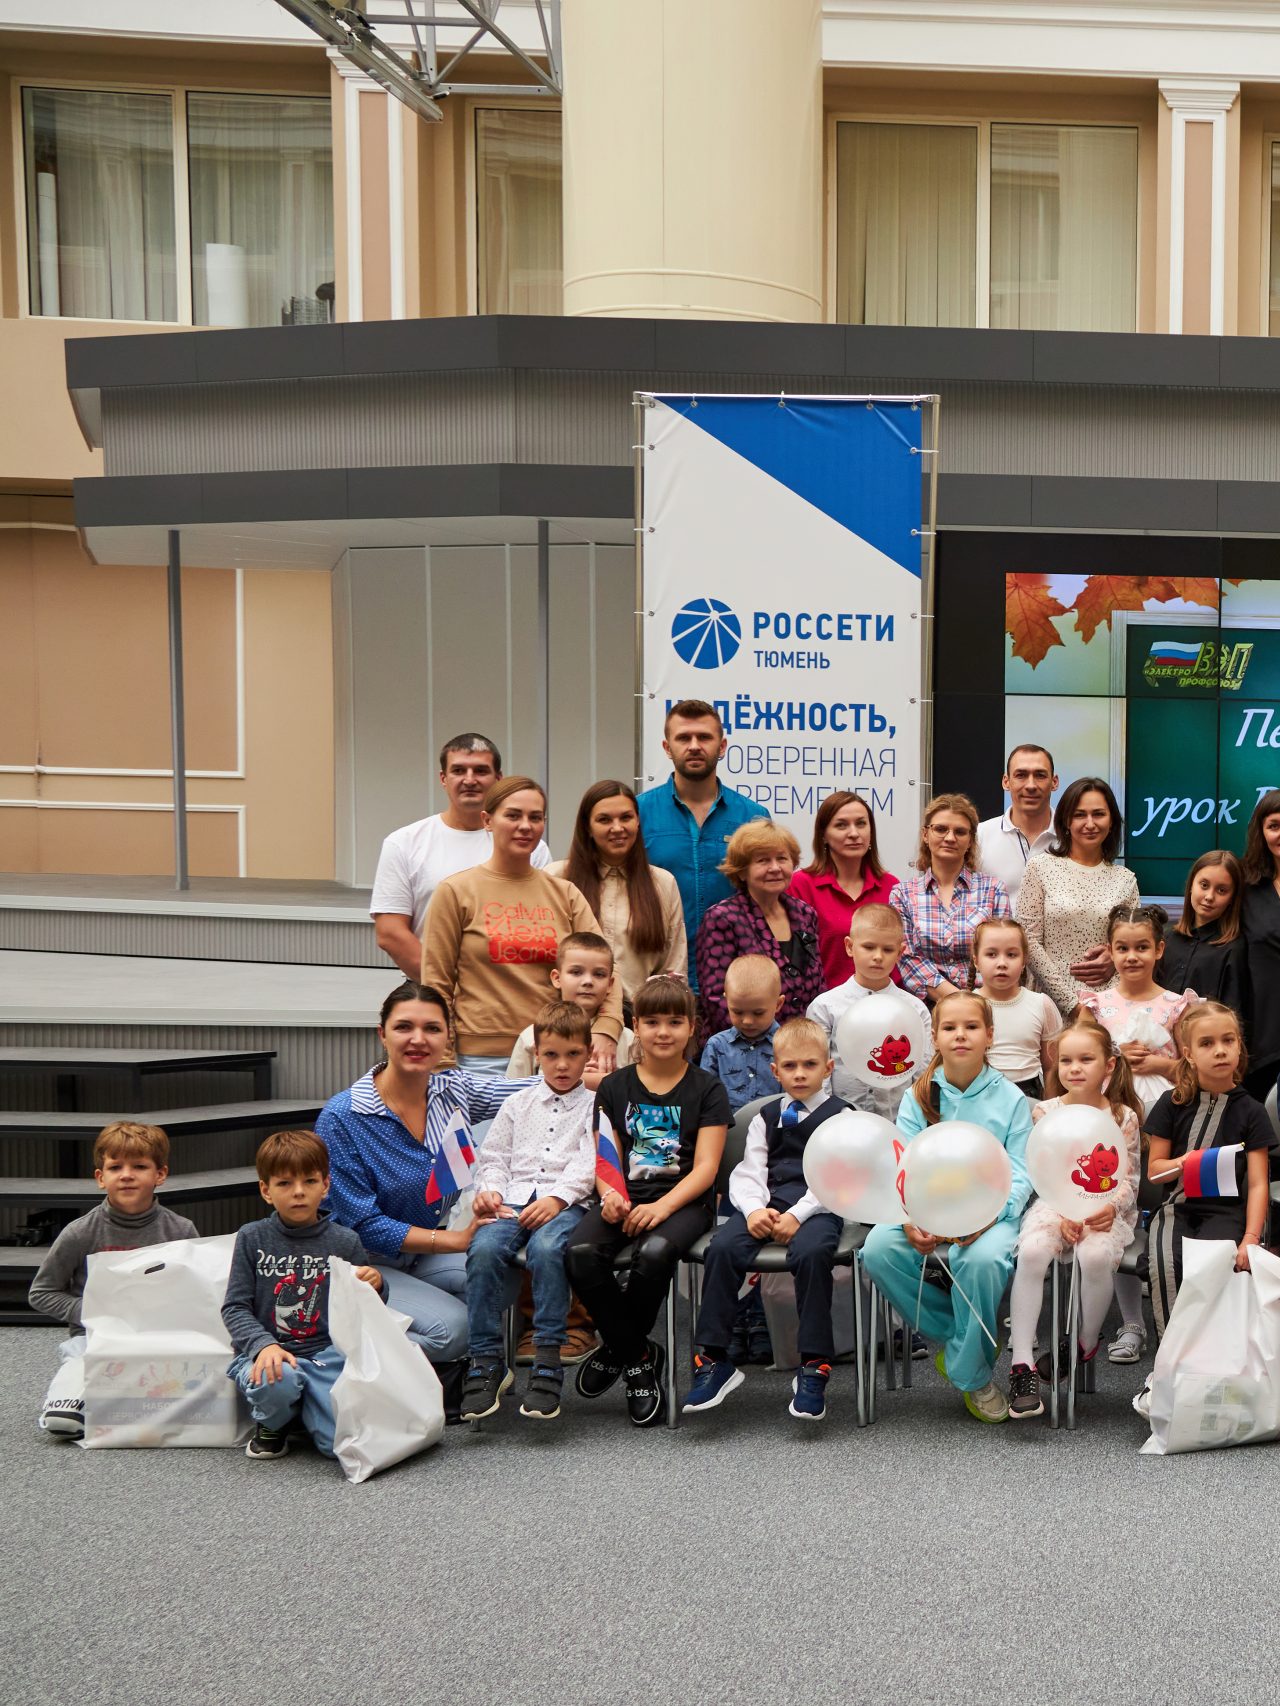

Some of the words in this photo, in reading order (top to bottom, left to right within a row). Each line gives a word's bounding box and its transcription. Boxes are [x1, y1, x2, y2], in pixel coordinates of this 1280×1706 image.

[753, 611, 894, 642] РОССЕТИ
[754, 650, 831, 669] ТЮМЕНЬ
[665, 694, 897, 739] ДЁЖНОСТЬ,
[718, 744, 896, 778] ОВЕРЕННАЯ
[1132, 796, 1241, 838] урок
[483, 900, 555, 921] Calvin
[485, 917, 558, 940] Klein
[490, 939, 558, 963] Jeans
